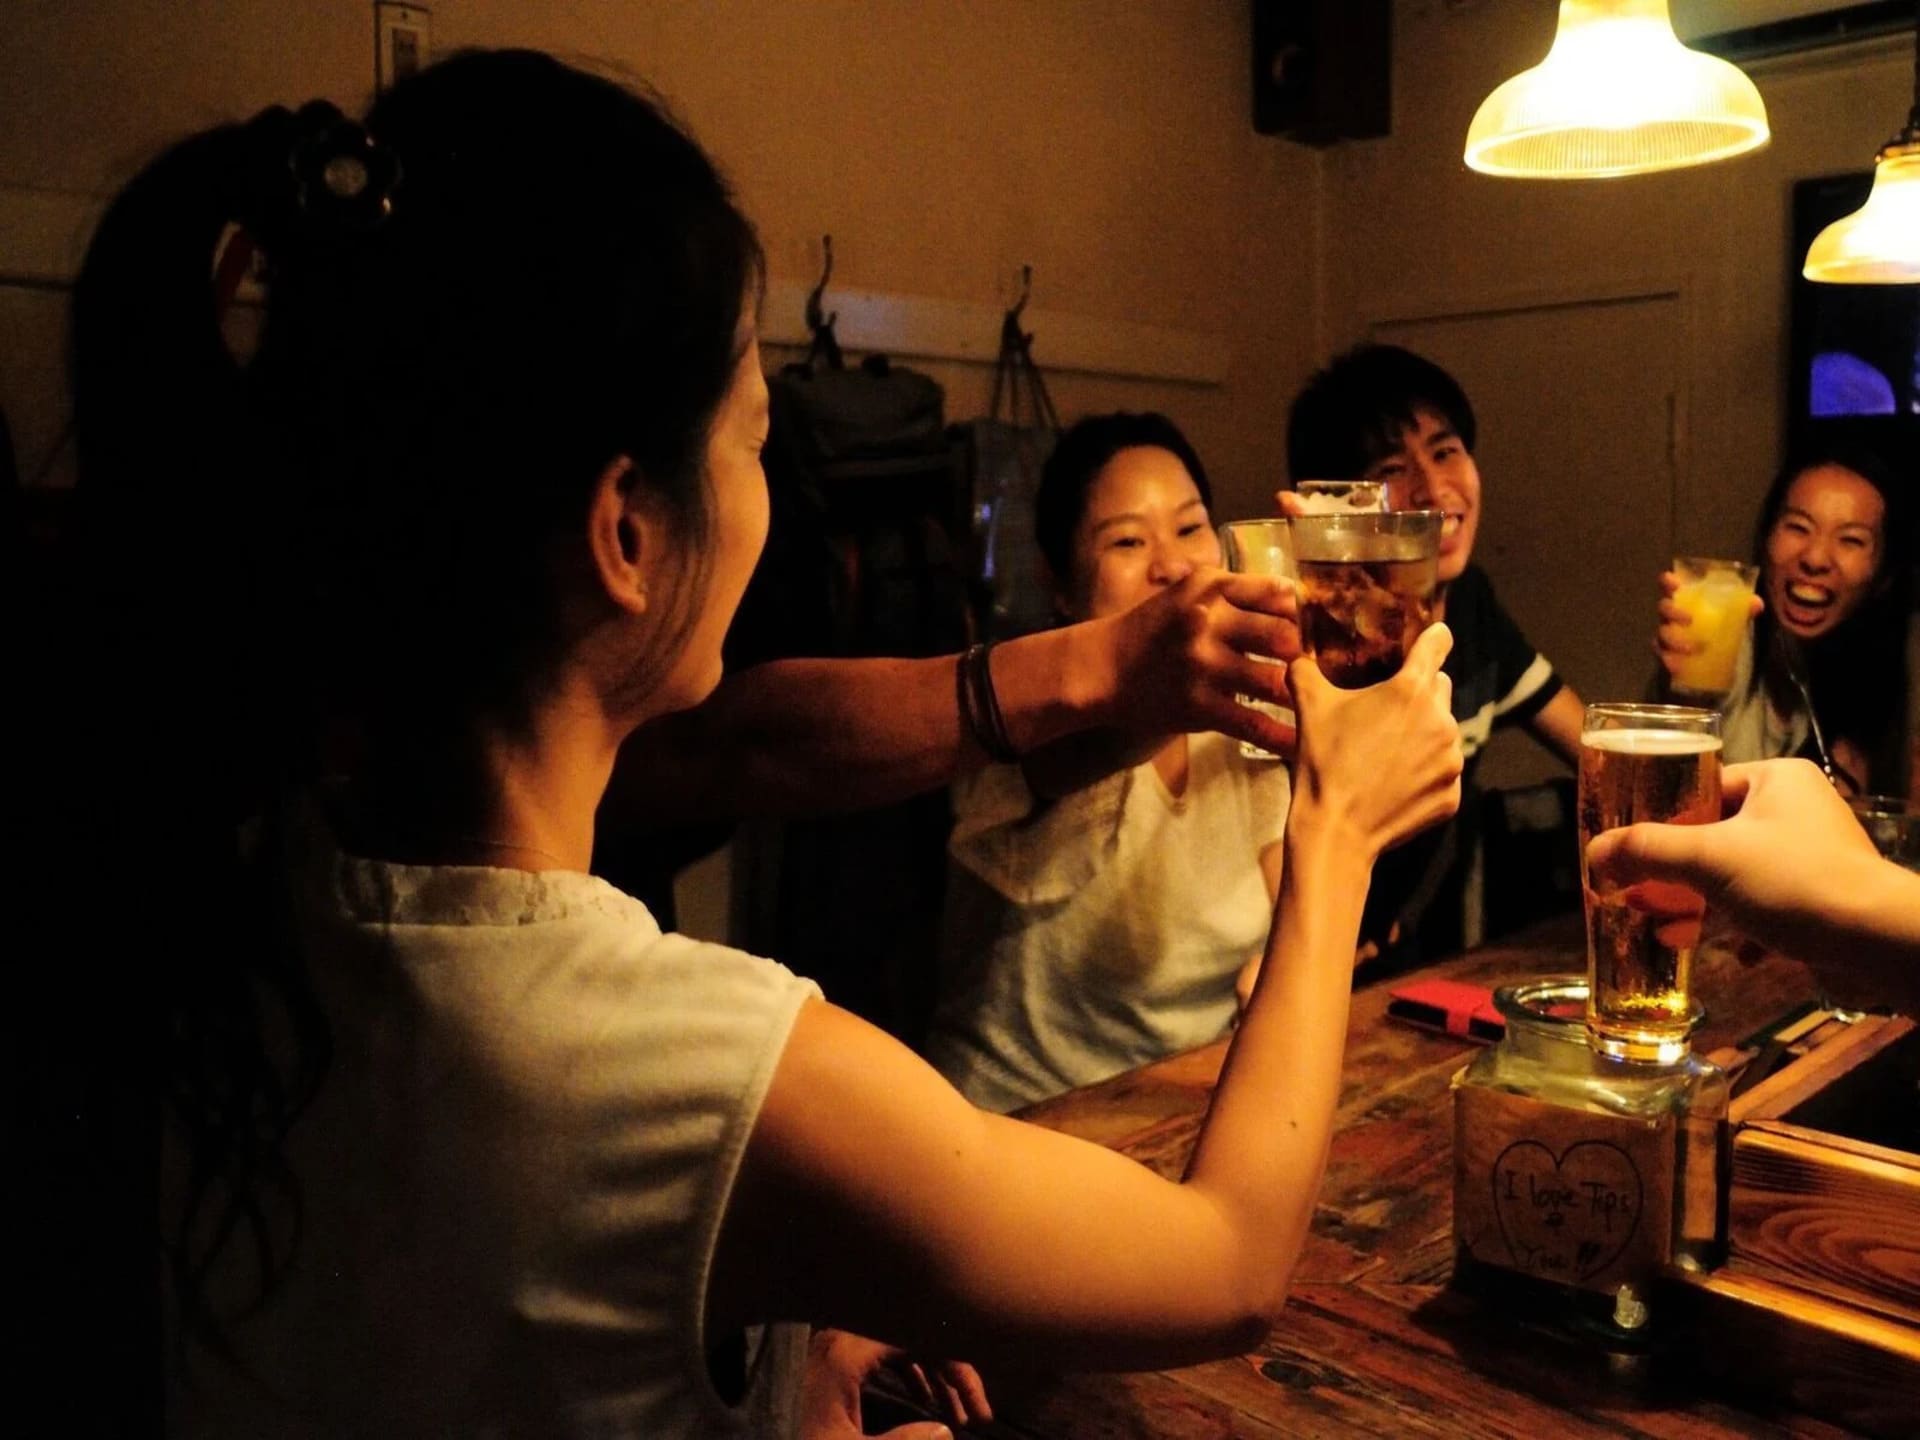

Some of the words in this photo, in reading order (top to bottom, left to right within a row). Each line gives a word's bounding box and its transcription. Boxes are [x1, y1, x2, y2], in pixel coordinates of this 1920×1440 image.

[1504, 1169, 1520, 1201] I
[1529, 1173, 1578, 1208] love
[1579, 1181, 1631, 1233] Tips
